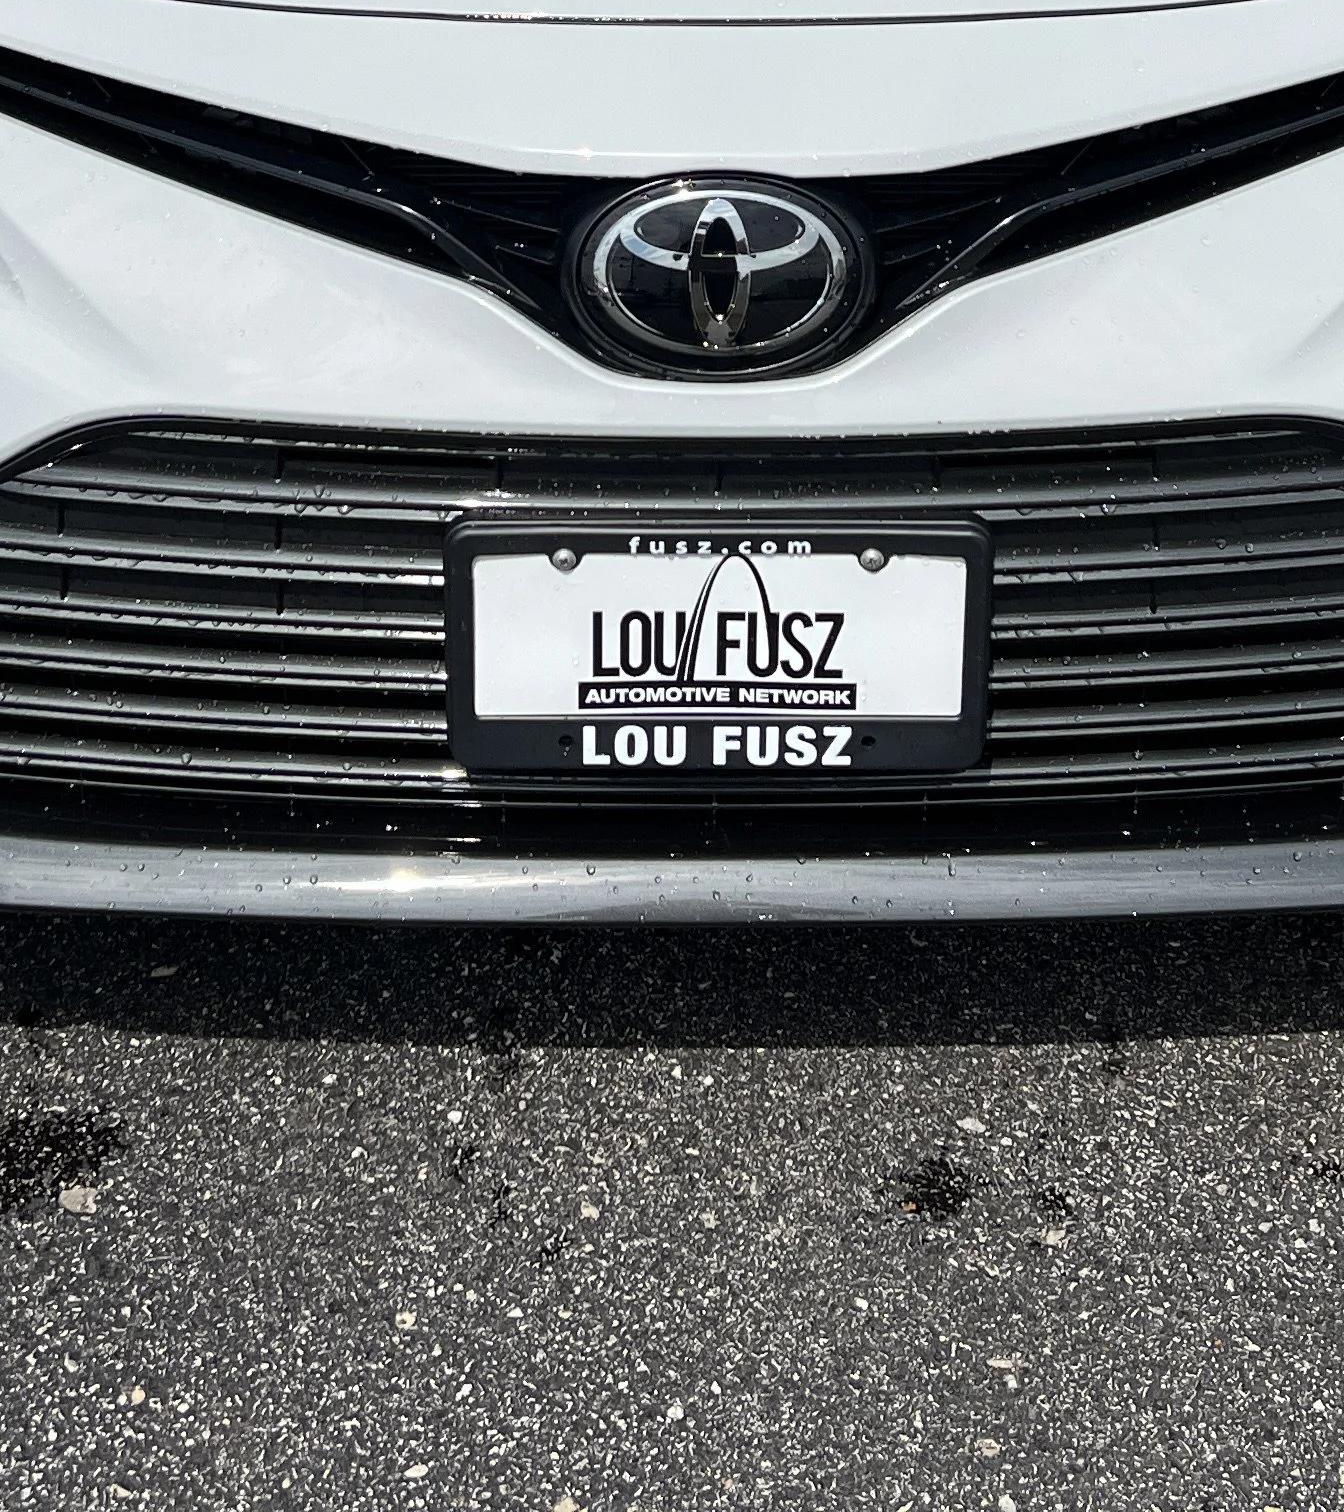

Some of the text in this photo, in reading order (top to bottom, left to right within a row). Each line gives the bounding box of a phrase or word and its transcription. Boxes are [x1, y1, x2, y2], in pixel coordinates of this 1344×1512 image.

[628, 535, 812, 555] fusz.com
[592, 610, 845, 679] LOU FUSZ
[584, 686, 852, 706] AUTOMOTIVE NETWORK
[582, 724, 854, 767] LOU FUSZ
